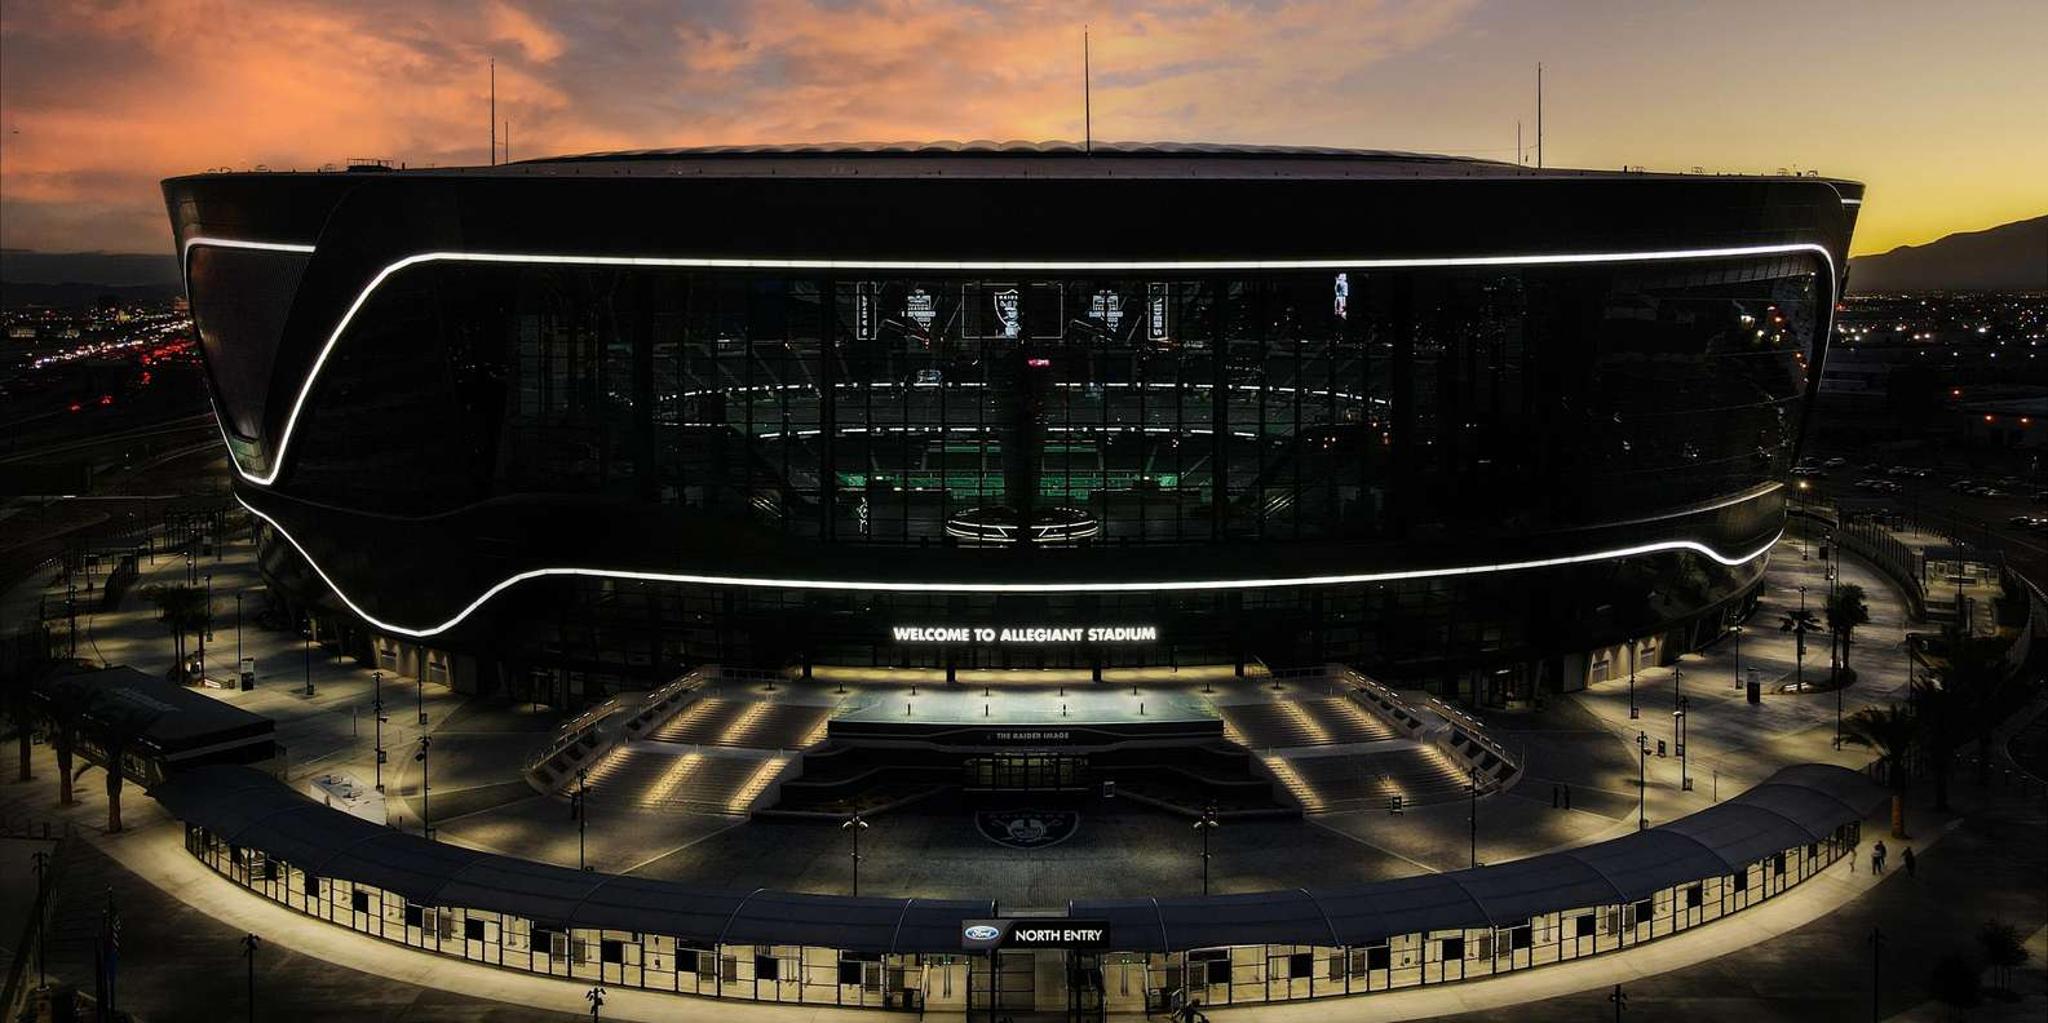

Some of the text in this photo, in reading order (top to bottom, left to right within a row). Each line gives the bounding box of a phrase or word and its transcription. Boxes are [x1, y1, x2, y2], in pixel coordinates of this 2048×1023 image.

[1153, 286, 1162, 336] IDERS
[893, 627, 1156, 642] WELCOME TO ALLEGIANT STADIUM
[996, 732, 1069, 740] THE RAIDER IMAGE
[1015, 929, 1103, 942] NORTH ENTRY
